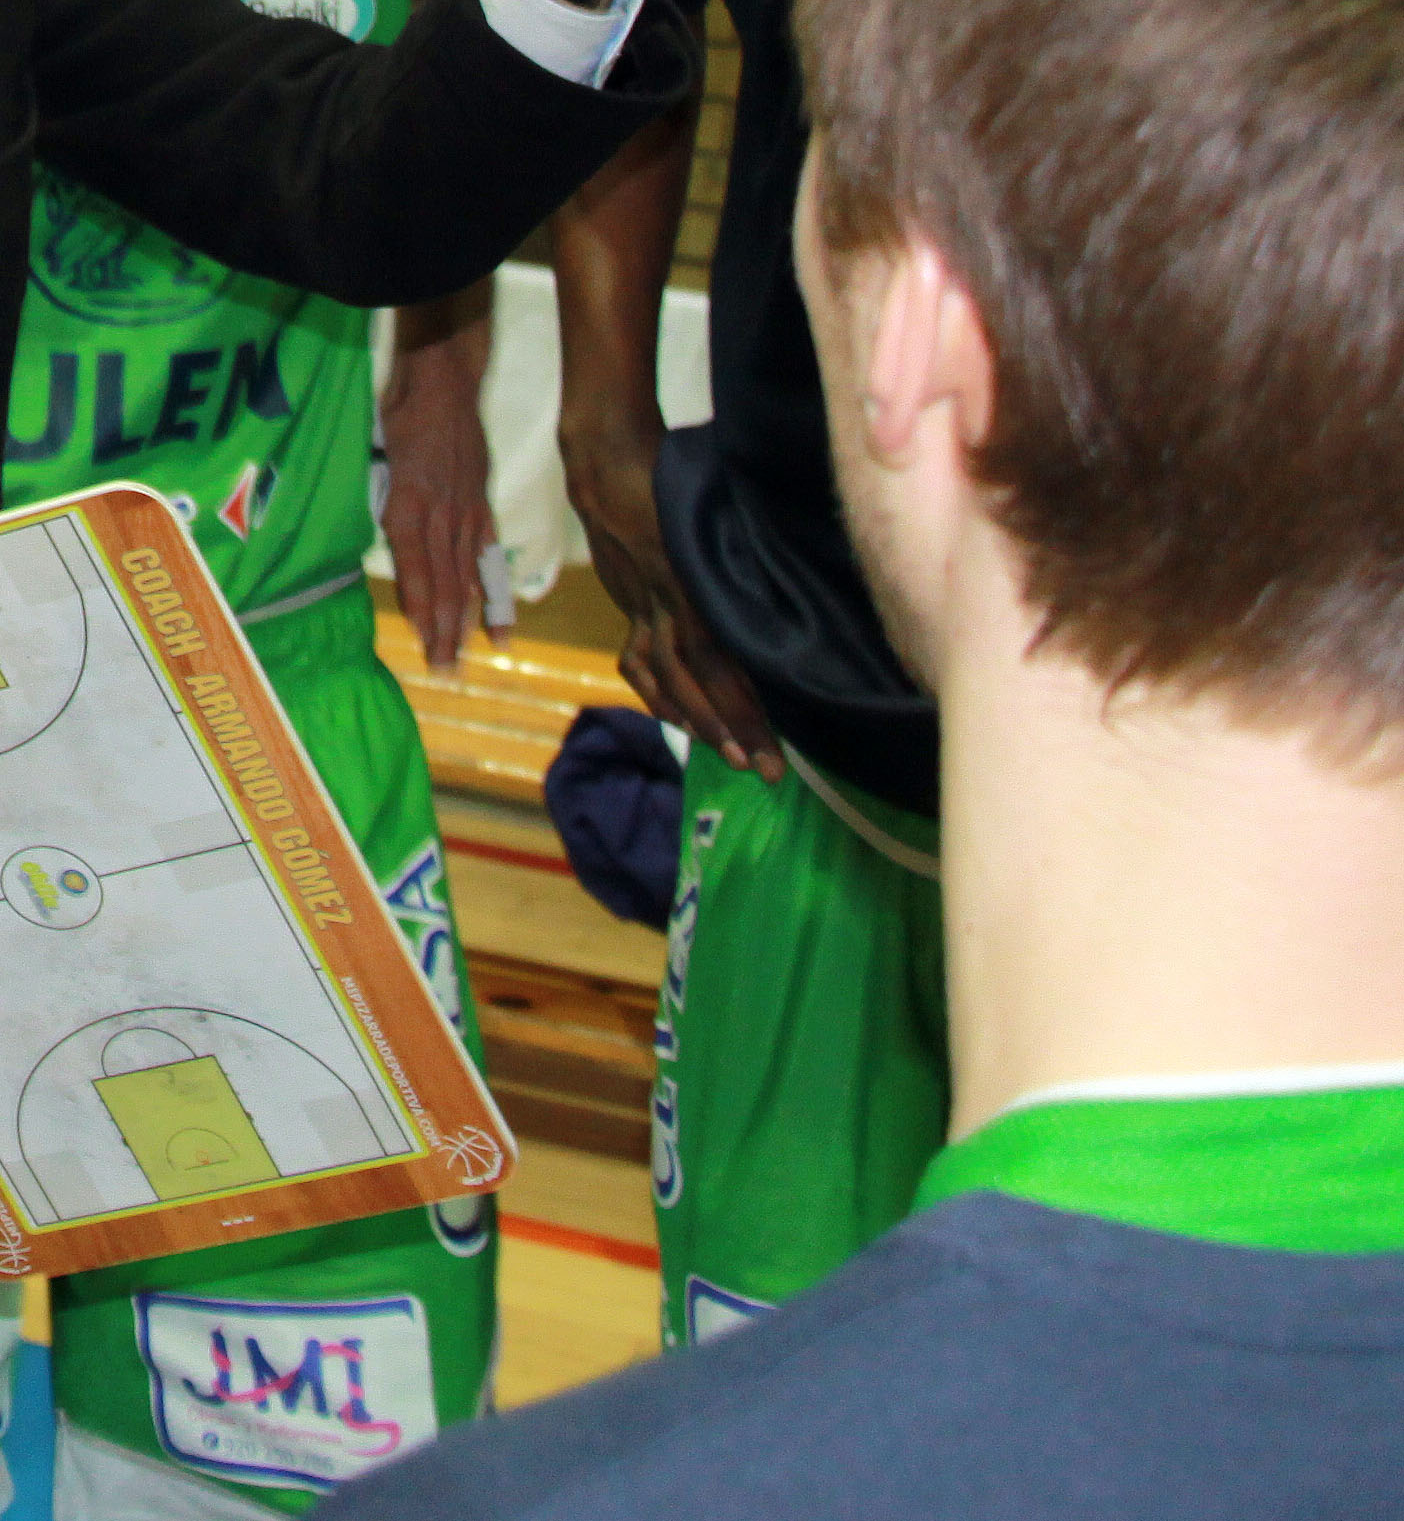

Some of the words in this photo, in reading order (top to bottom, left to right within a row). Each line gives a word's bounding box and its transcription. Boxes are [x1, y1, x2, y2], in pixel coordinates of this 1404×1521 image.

[3, 339, 291, 464] ULEN
[121, 547, 207, 658] COACH
[186, 673, 293, 822] ARMANDO
[272, 826, 352, 930] GÓMEZ
